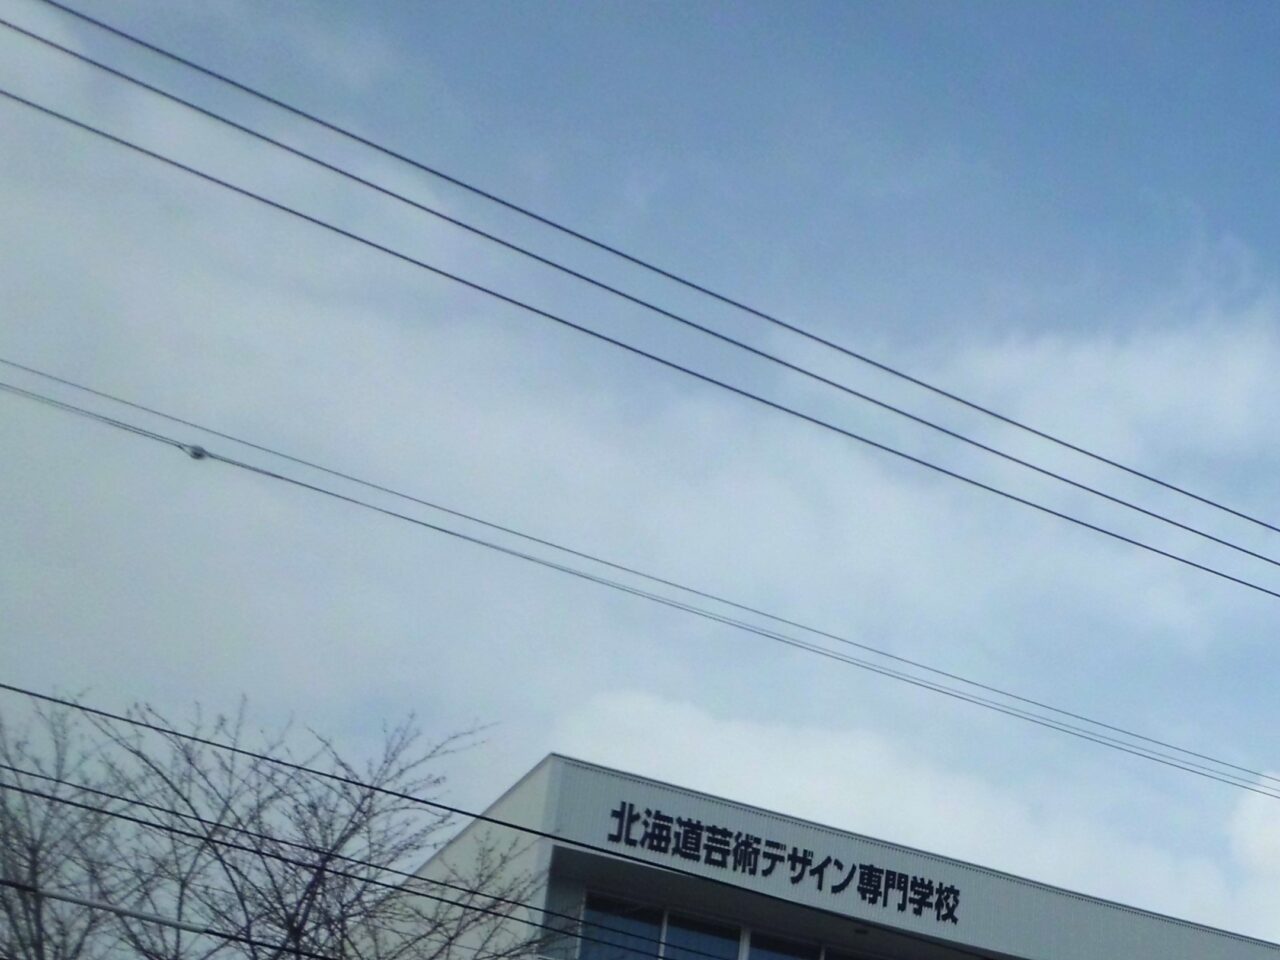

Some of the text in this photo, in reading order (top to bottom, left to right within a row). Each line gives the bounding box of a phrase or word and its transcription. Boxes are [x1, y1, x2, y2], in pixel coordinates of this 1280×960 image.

[607, 801, 960, 925] 北海道芸術デザイン専門学校
